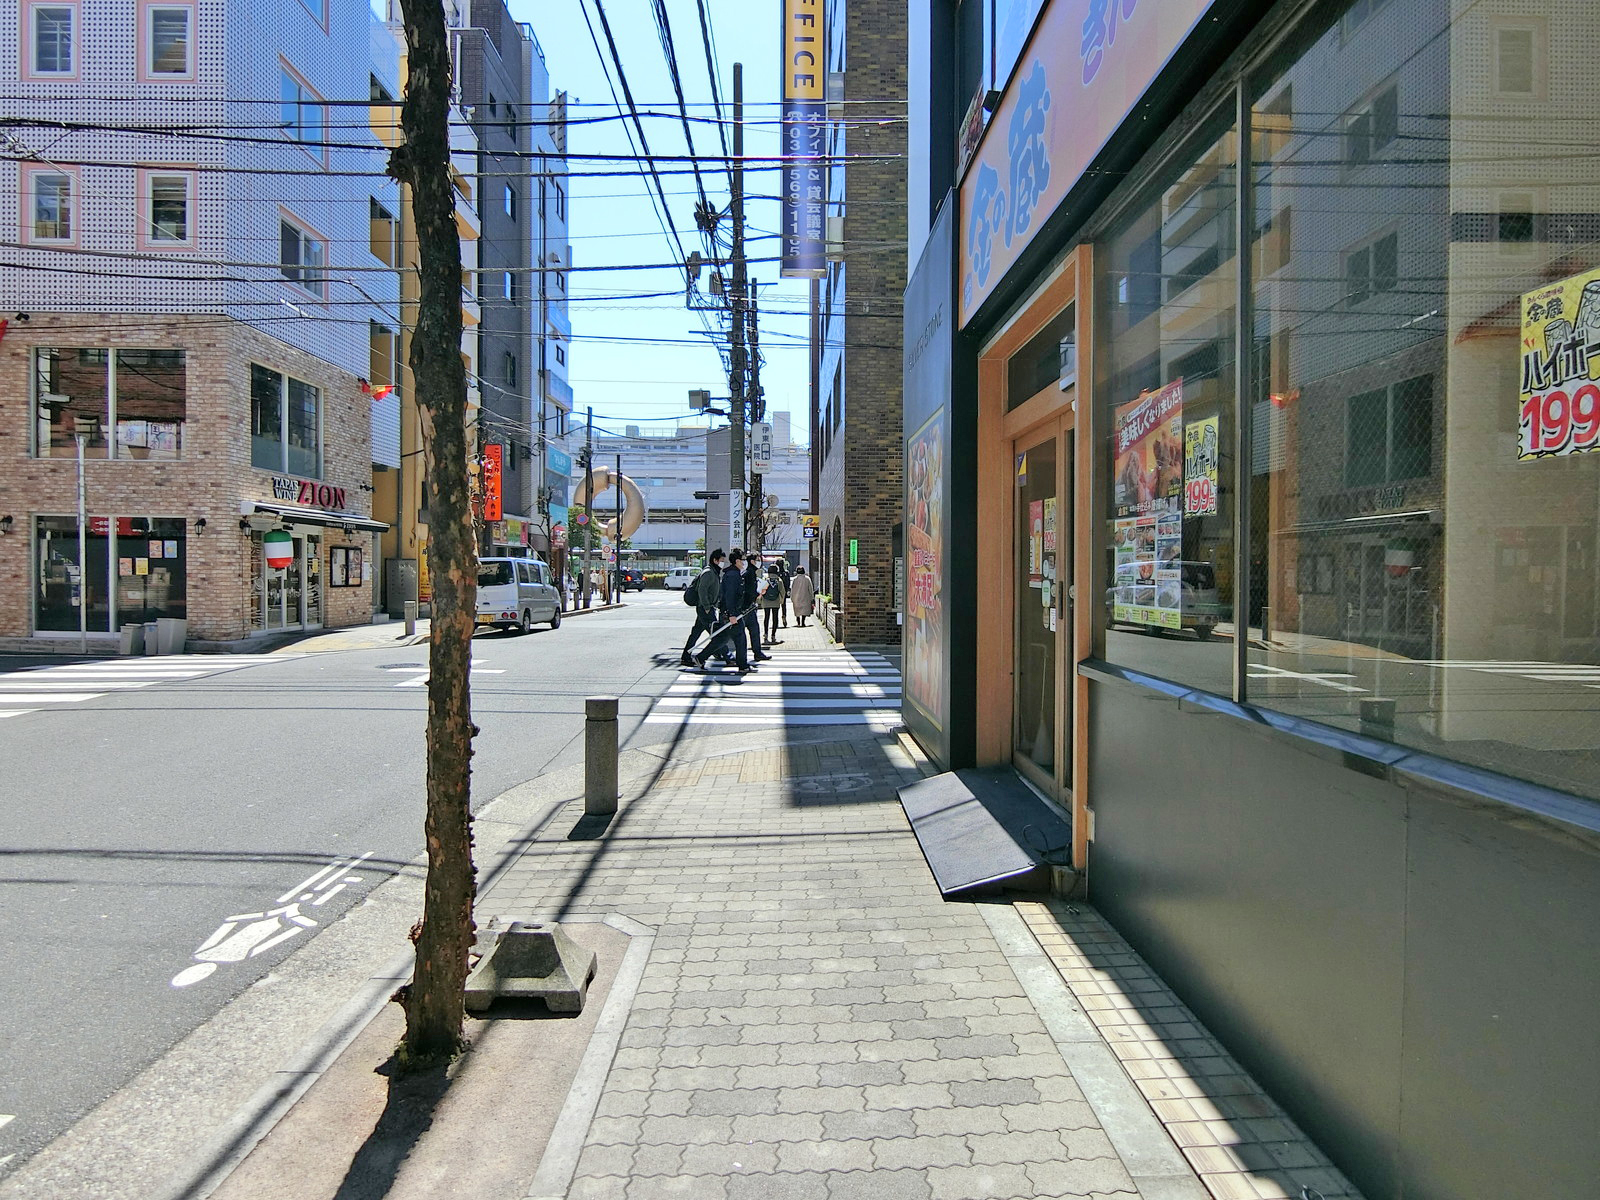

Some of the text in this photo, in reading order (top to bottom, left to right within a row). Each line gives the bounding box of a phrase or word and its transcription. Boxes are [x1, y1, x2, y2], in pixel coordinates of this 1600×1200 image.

[794, 0, 815, 88] FICE
[1527, 296, 1563, 323] 金の蔵
[1522, 383, 1600, 450] 199
[273, 476, 299, 491] TAPAS
[274, 487, 298, 501] WINE
[297, 480, 348, 509] ZION
[732, 490, 741, 539] ツノダ会計
